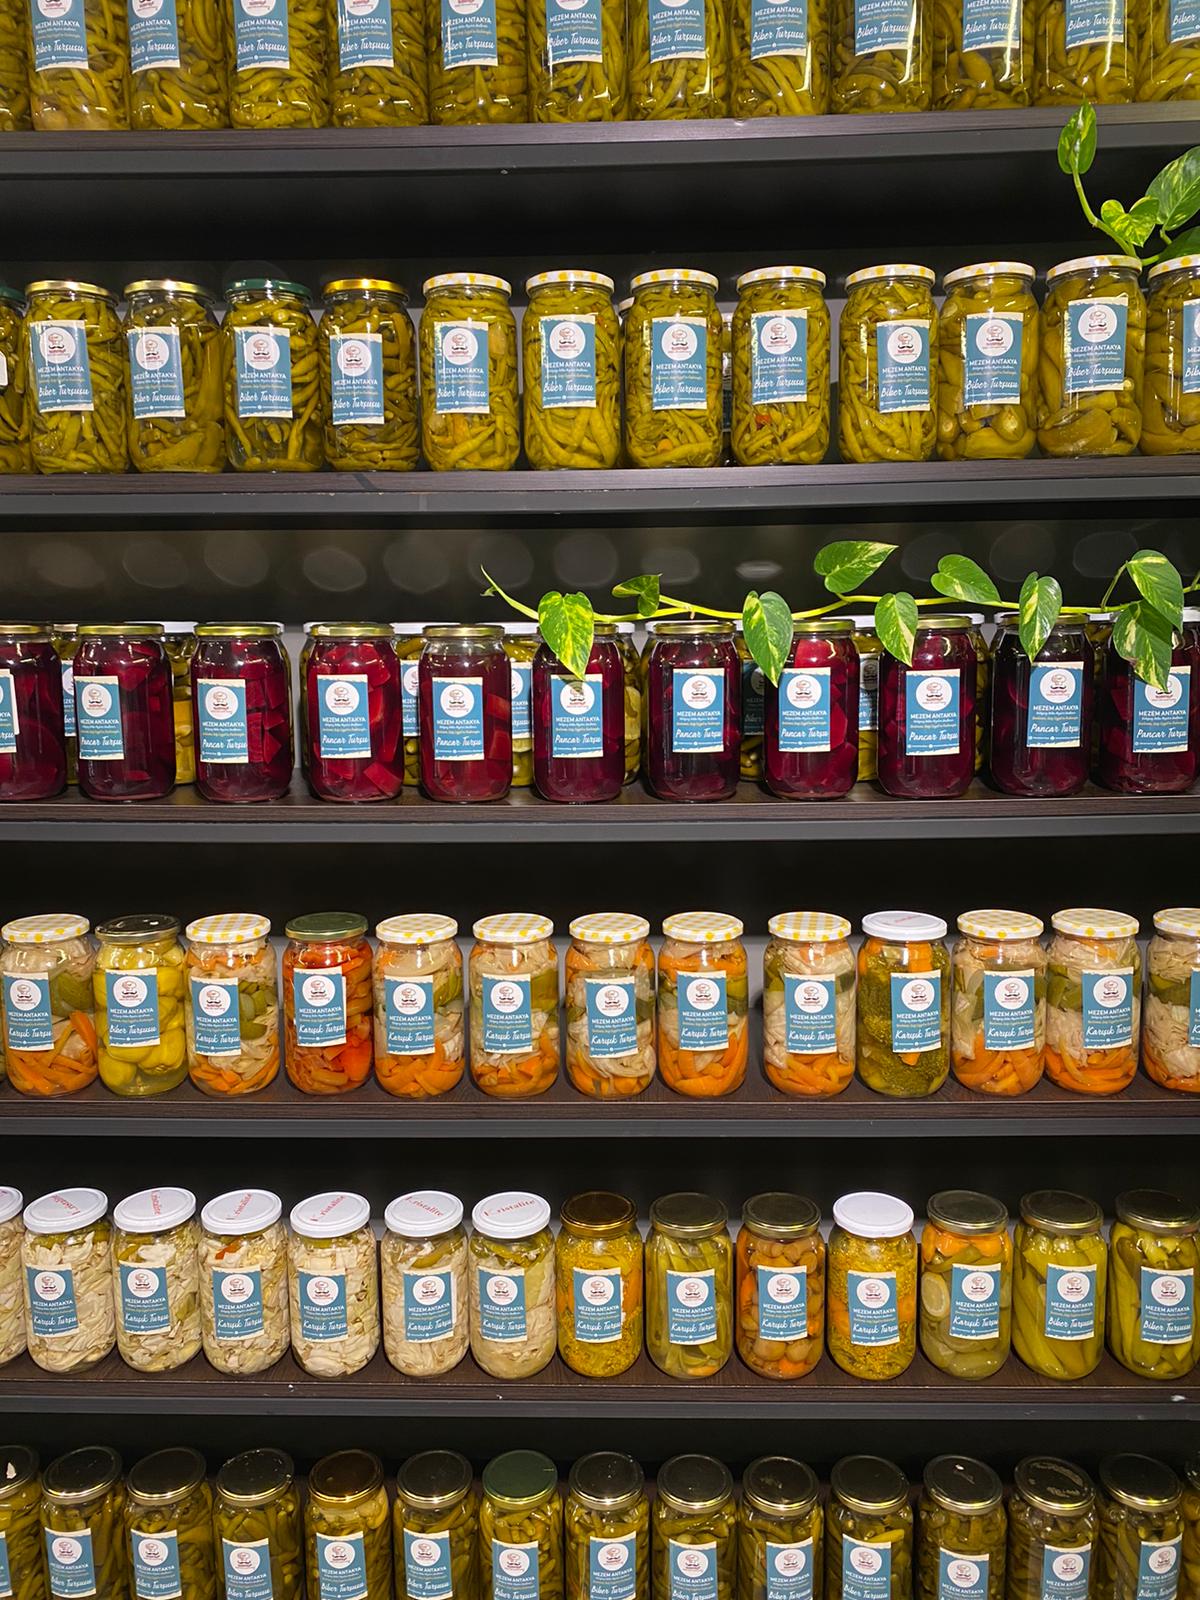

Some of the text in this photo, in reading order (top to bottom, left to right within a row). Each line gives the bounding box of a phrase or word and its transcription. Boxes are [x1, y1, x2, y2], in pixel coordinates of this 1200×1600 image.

[237, 20, 256, 28] MEZEM
[550, 36, 568, 47] Biber
[651, 34, 672, 45] Biber
[753, 32, 773, 42] Biber
[238, 43, 257, 54] Biber
[1068, 365, 1090, 377] Biber
[544, 381, 562, 392] Biber
[654, 384, 673, 394] Biber
[966, 378, 987, 390] Biber
[39, 385, 56, 396] Biber
[240, 390, 257, 401] Biber
[437, 386, 455, 398] Biber
[880, 387, 901, 398] Biber
[781, 728, 806, 737] Pancar
[1031, 723, 1060, 733] Pancar
[1137, 728, 1166, 738] Pancar
[555, 734, 580, 744] Pancar
[675, 729, 701, 739] Pancar
[909, 731, 937, 741] Pancar
[81, 736, 99, 746] Pancar
[202, 739, 223, 749] Pancar
[322, 735, 346, 744] Pancar
[436, 736, 460, 746] Pancar
[916, 1010, 938, 1018] ANTAKYA
[299, 1024, 323, 1033] Karışık
[681, 1027, 708, 1038] Karışık
[988, 1028, 1015, 1037] Karışık
[389, 1032, 413, 1042] Karışık
[789, 1030, 815, 1042] Karışık
[895, 1029, 922, 1040] Karışık
[591, 1035, 617, 1045] Karışık
[427, 1303, 450, 1311] ANTAKYA
[303, 1320, 326, 1331] Karışık
[407, 1321, 432, 1330] Karışık
[576, 1320, 602, 1330] Karışık
[954, 1316, 979, 1326] Karışık
[671, 1322, 696, 1333] Karışık
